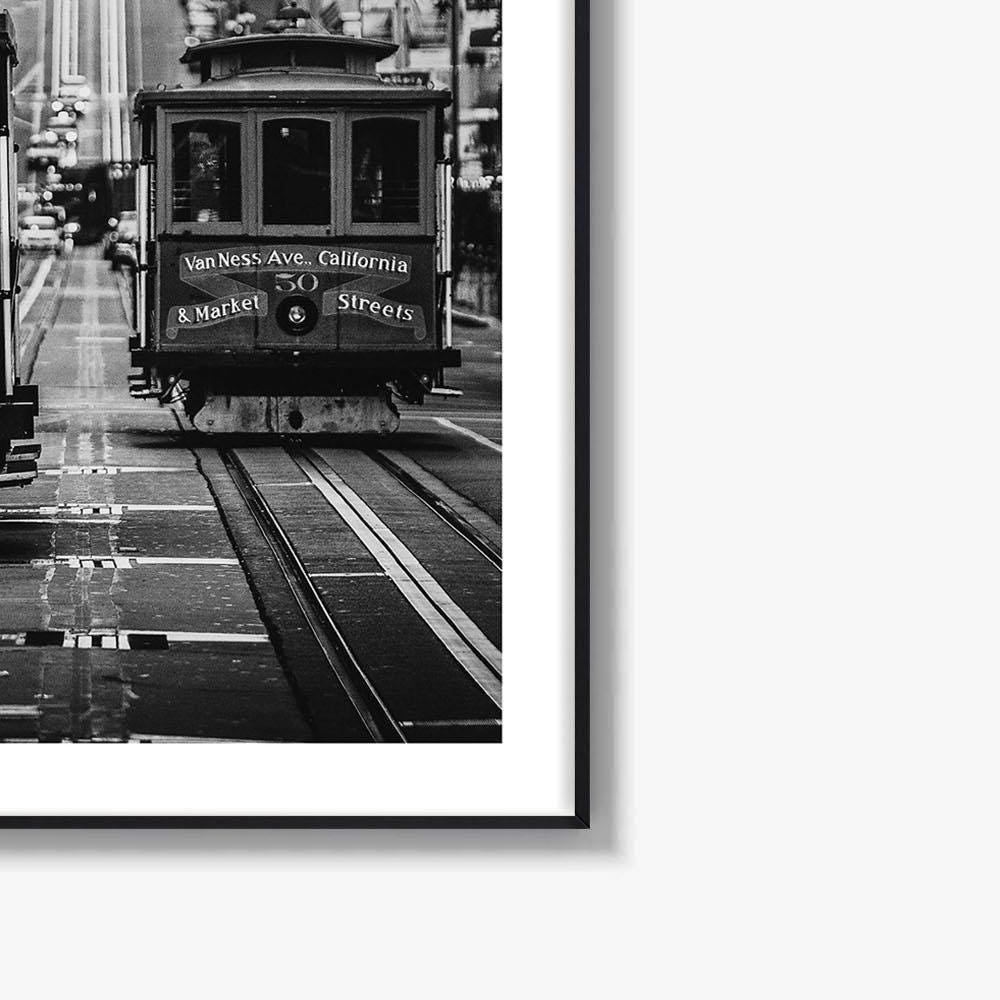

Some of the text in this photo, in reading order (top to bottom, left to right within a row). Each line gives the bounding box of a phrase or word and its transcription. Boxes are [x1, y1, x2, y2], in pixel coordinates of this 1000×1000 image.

[318, 250, 408, 273] California
[274, 273, 319, 292] 50
[177, 293, 414, 324] & Market Streets
